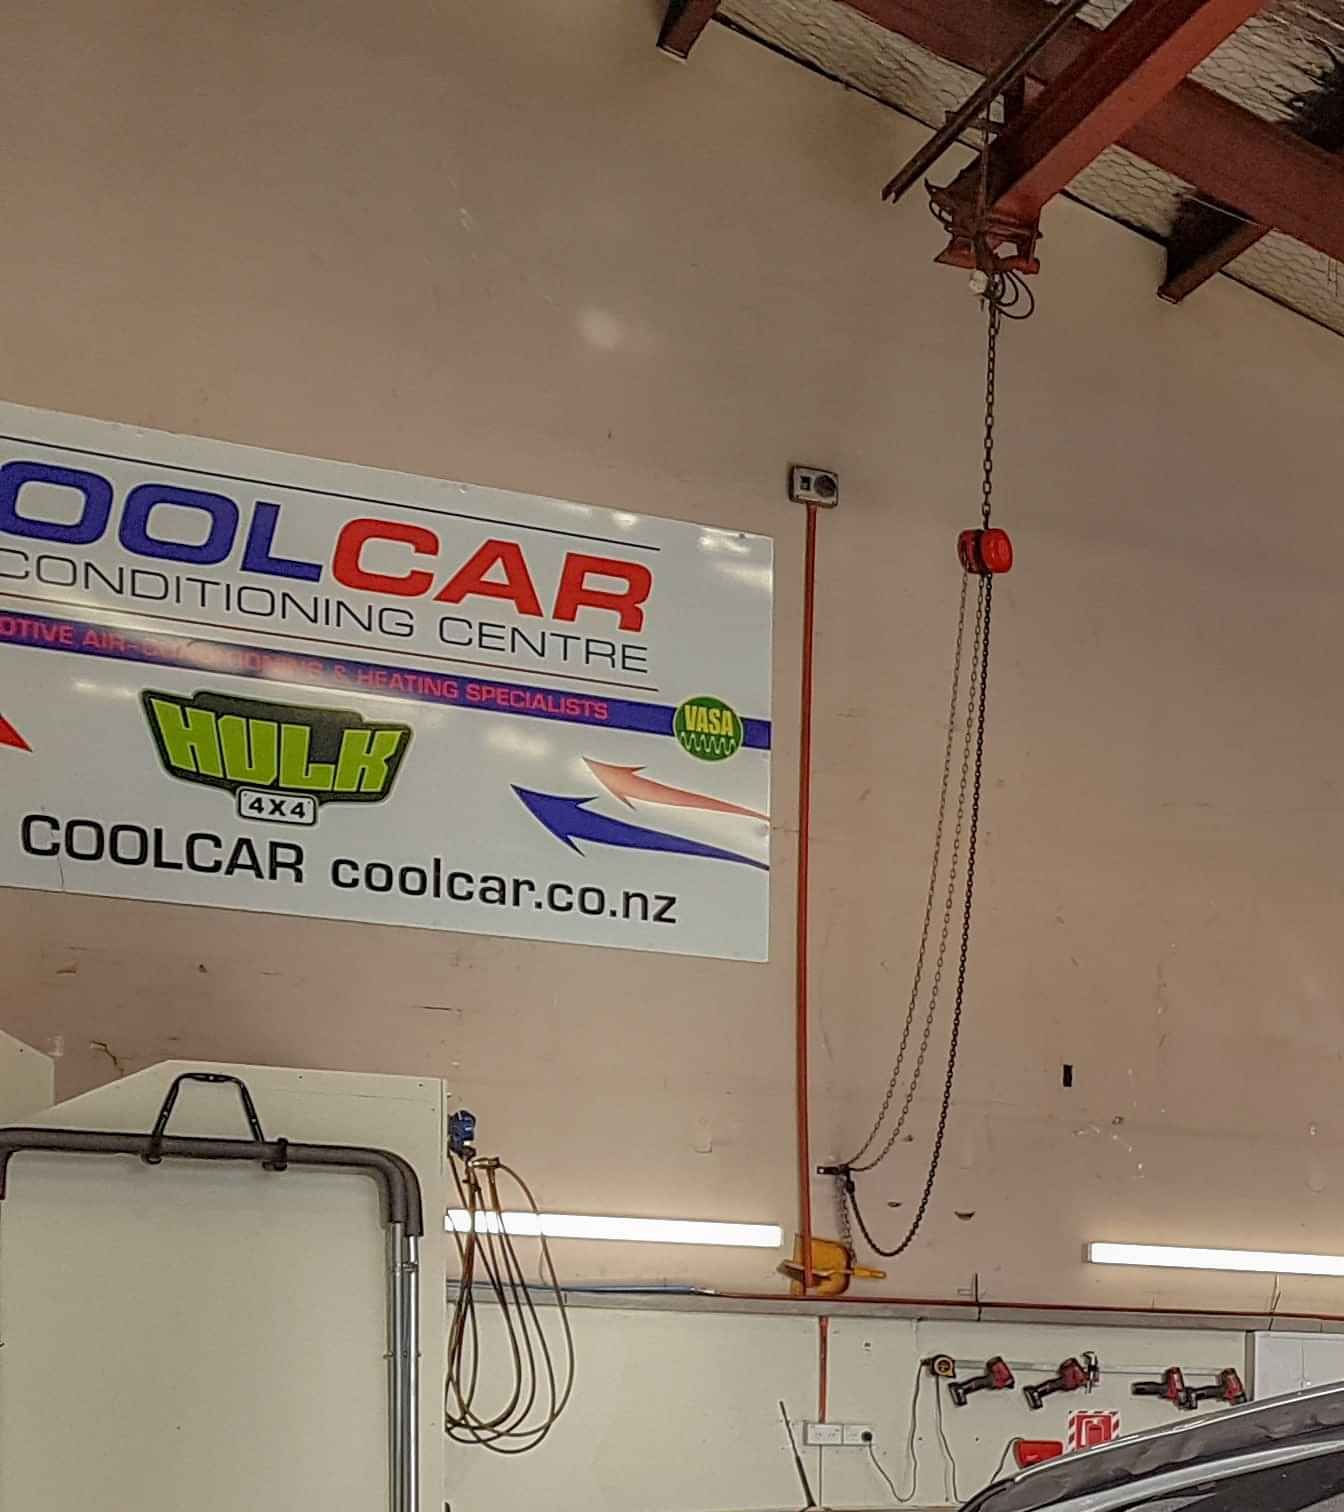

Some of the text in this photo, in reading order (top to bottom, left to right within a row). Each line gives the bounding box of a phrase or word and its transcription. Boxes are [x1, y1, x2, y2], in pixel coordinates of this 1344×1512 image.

[438, 615, 649, 673] CENTRE
[357, 669, 460, 701] HEATING
[464, 682, 609, 721] SPECIALISTS
[684, 704, 734, 737] VASA
[149, 695, 405, 795] HULK
[247, 795, 308, 821] 4X4
[20, 813, 679, 925] COOLCAR coolcar.co.nz
